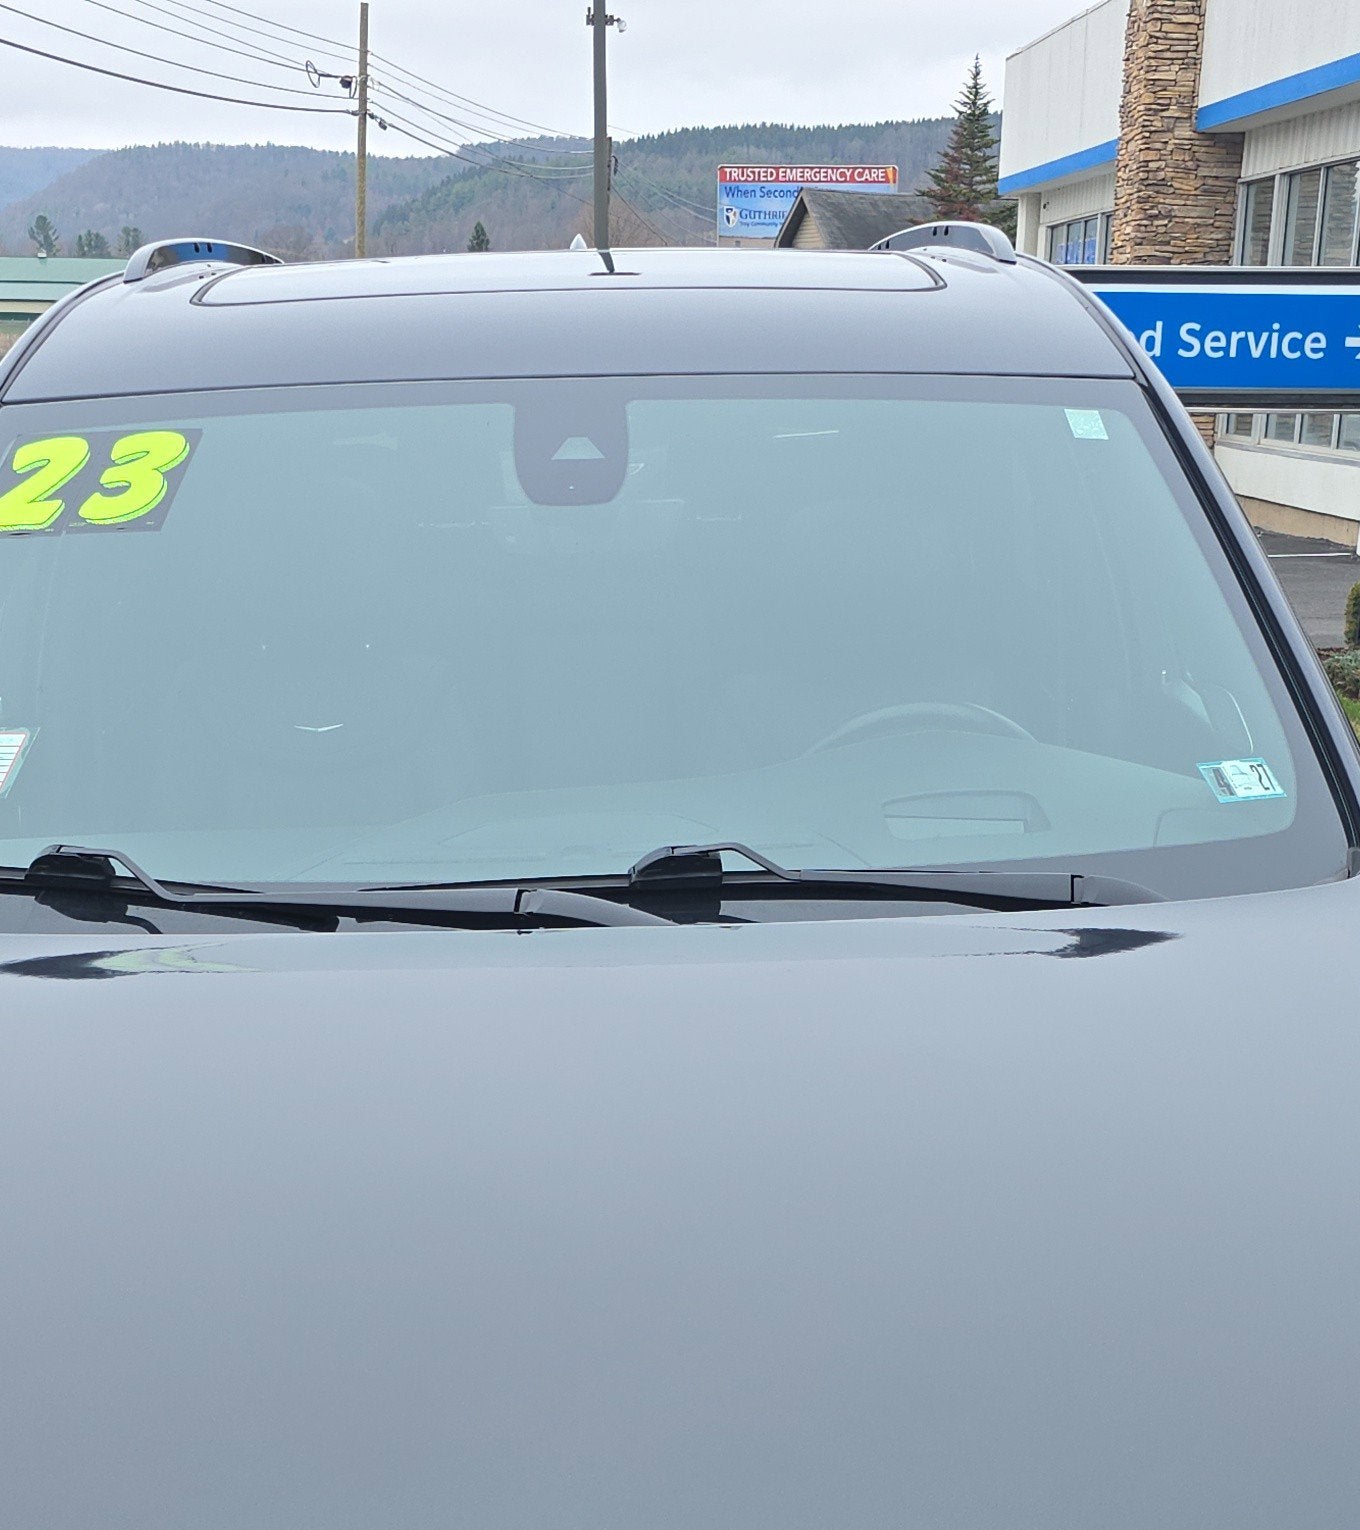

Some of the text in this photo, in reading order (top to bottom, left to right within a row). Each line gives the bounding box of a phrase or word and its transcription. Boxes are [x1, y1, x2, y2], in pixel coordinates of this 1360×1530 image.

[725, 168, 886, 182] TRUSTED EMERGENCY CARE
[725, 186, 756, 198] When
[1177, 322, 1327, 359] Service
